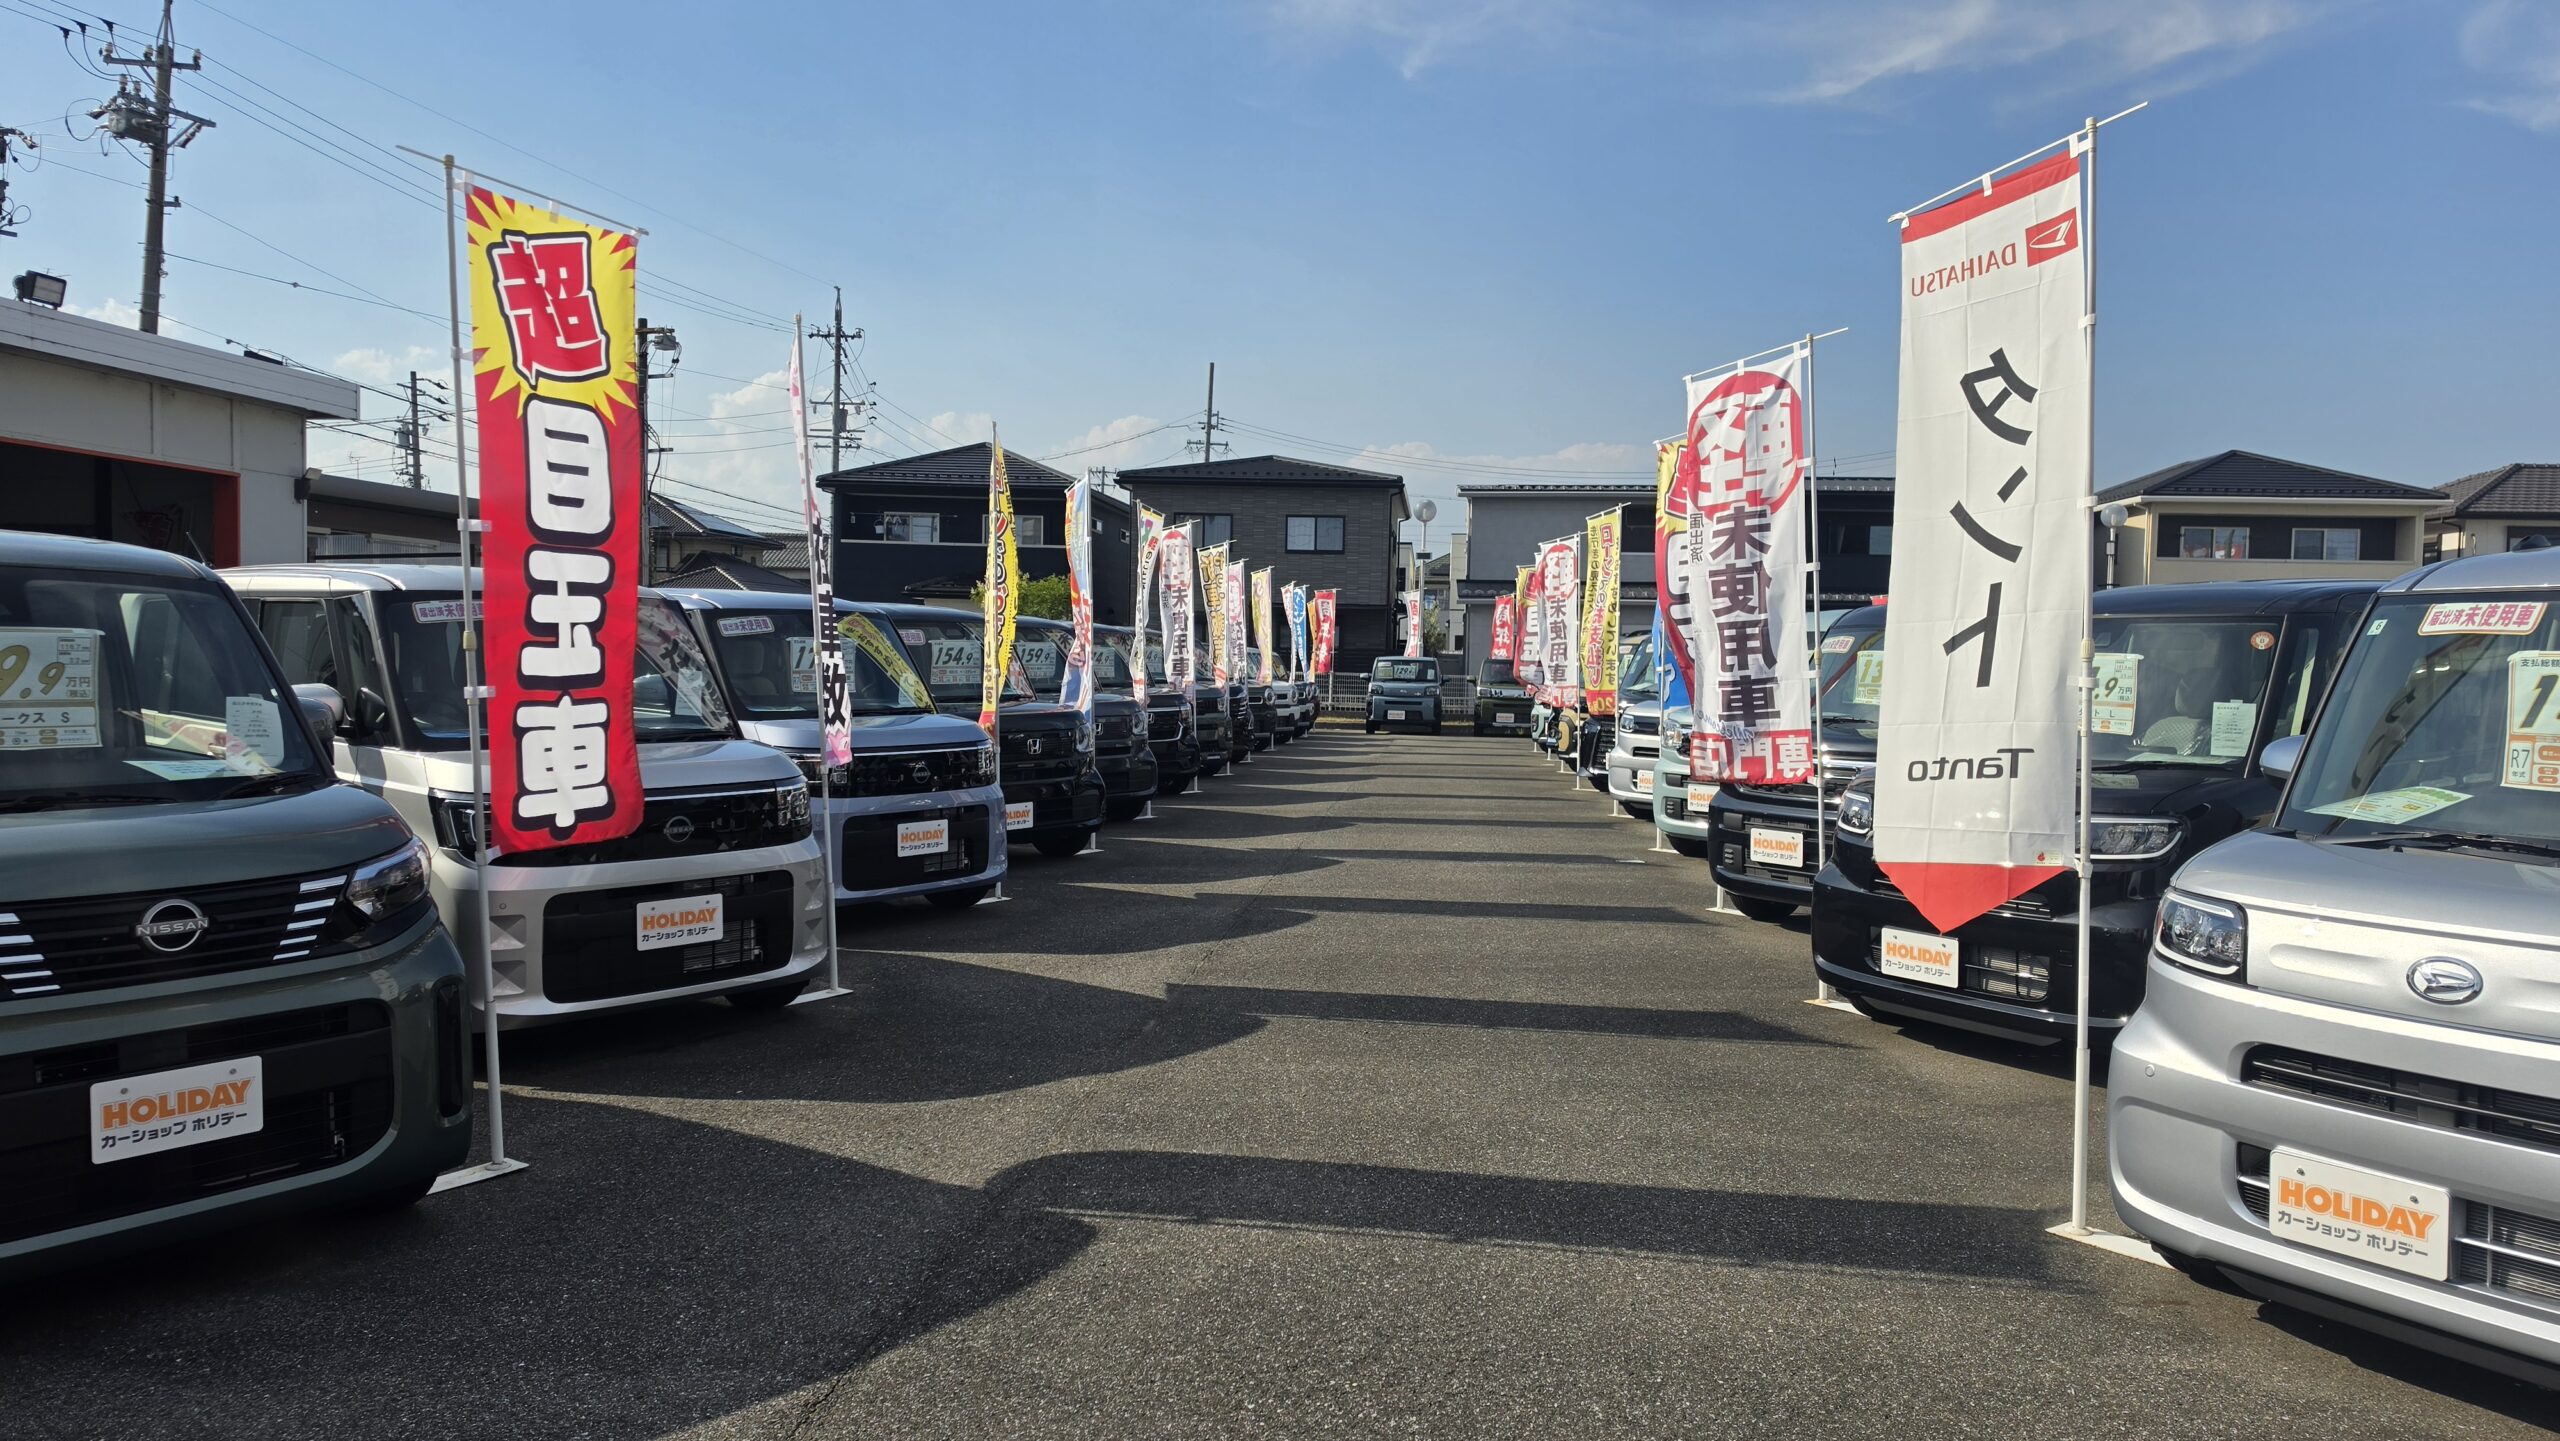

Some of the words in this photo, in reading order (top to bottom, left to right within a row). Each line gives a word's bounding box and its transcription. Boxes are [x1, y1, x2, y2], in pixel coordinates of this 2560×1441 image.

[486, 228, 616, 840] 超目玉車
[2428, 603, 2537, 627] 届出済未使用車
[934, 646, 974, 666] 154.9
[1020, 647, 1051, 663] 159.9
[65, 676, 91, 688] 万円
[61, 711, 70, 723] S
[2510, 748, 2531, 768] R7
[900, 828, 945, 843] HOLIDAY
[1753, 837, 1800, 853] HOLIDAY
[135, 916, 210, 937] NISSAN
[642, 907, 717, 931] HOLIDAY
[641, 928, 685, 942] カーショップ
[686, 926, 715, 938] ホリデー
[1886, 942, 1953, 966] HOLIDAY
[1885, 959, 1922, 973] カーショップ
[1924, 967, 1951, 977] ホリデー
[102, 1078, 252, 1130] HOLIDAY
[101, 1121, 187, 1149] カーショップ
[192, 1113, 248, 1132] ホリデー
[2279, 1178, 2437, 1241] HOLIDAY
[2278, 1210, 2361, 1242] カーショップ
[2366, 1234, 2429, 1257] ホリデー
